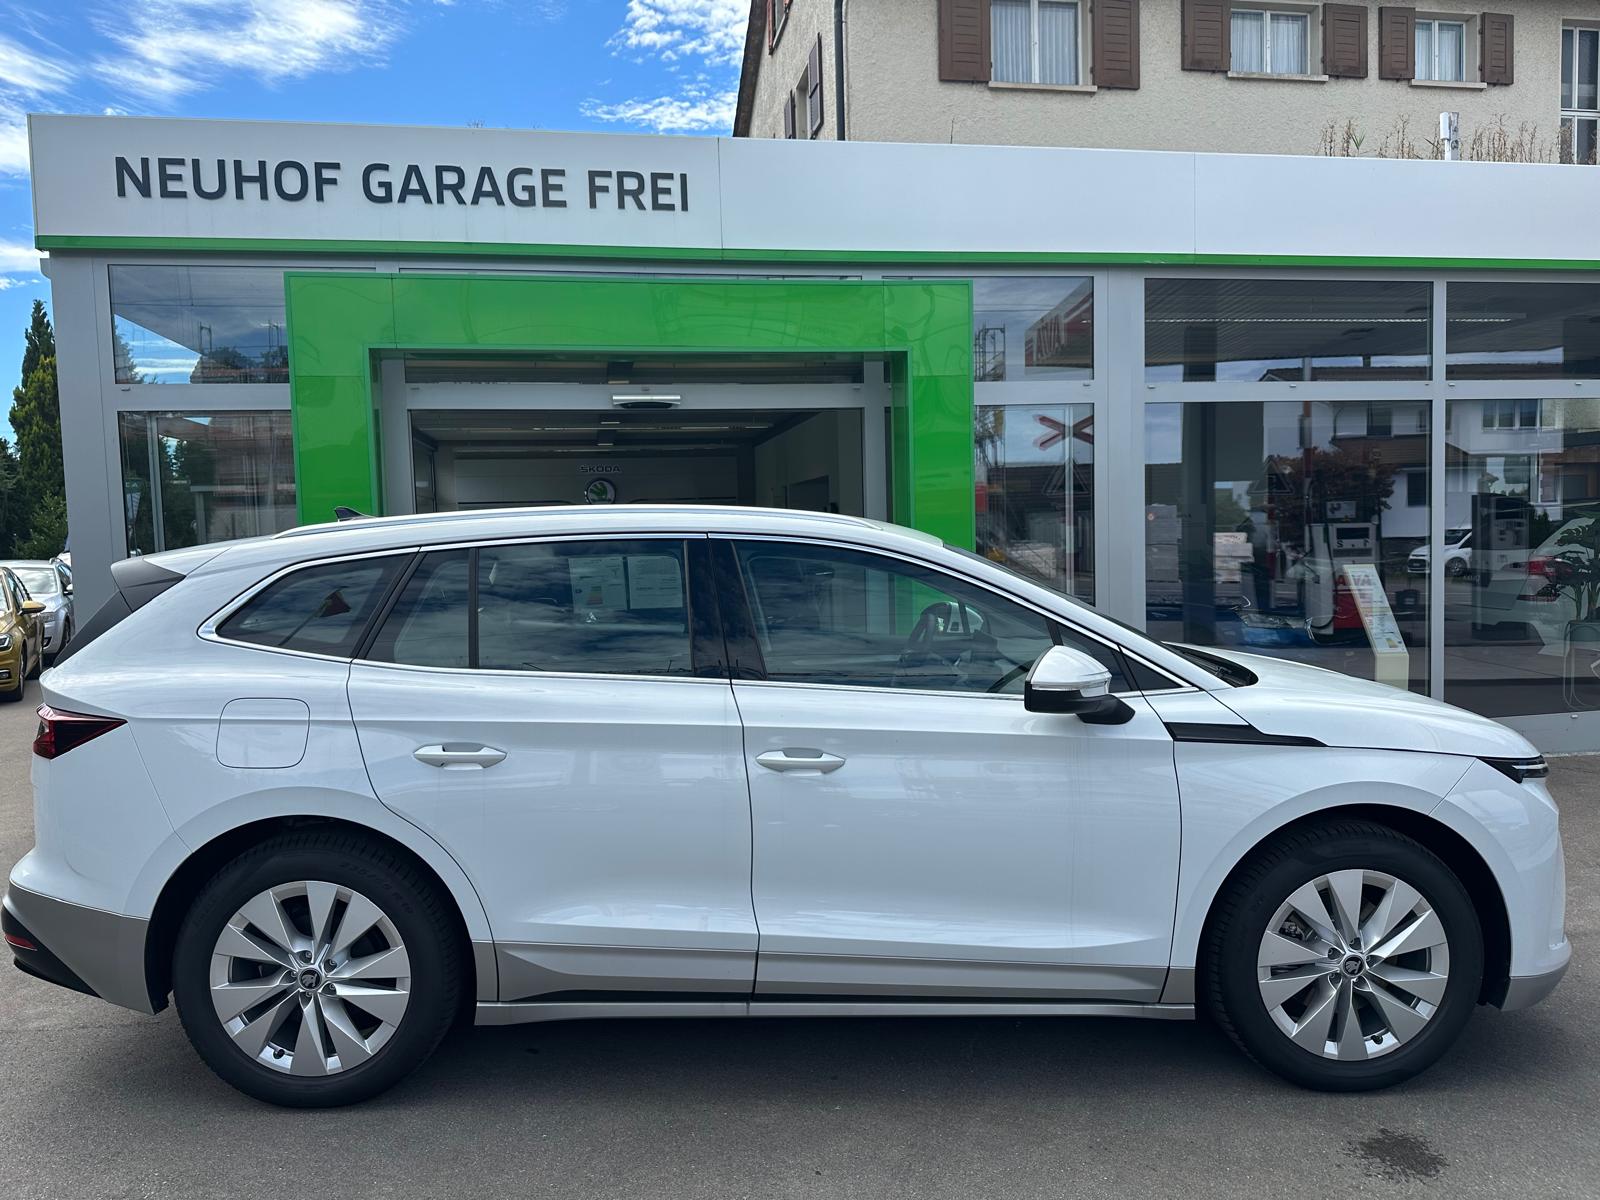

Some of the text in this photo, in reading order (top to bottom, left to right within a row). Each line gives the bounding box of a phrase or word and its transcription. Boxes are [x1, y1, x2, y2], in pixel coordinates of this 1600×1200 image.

[114, 156, 690, 212] NEUHOF GARAGE FREI
